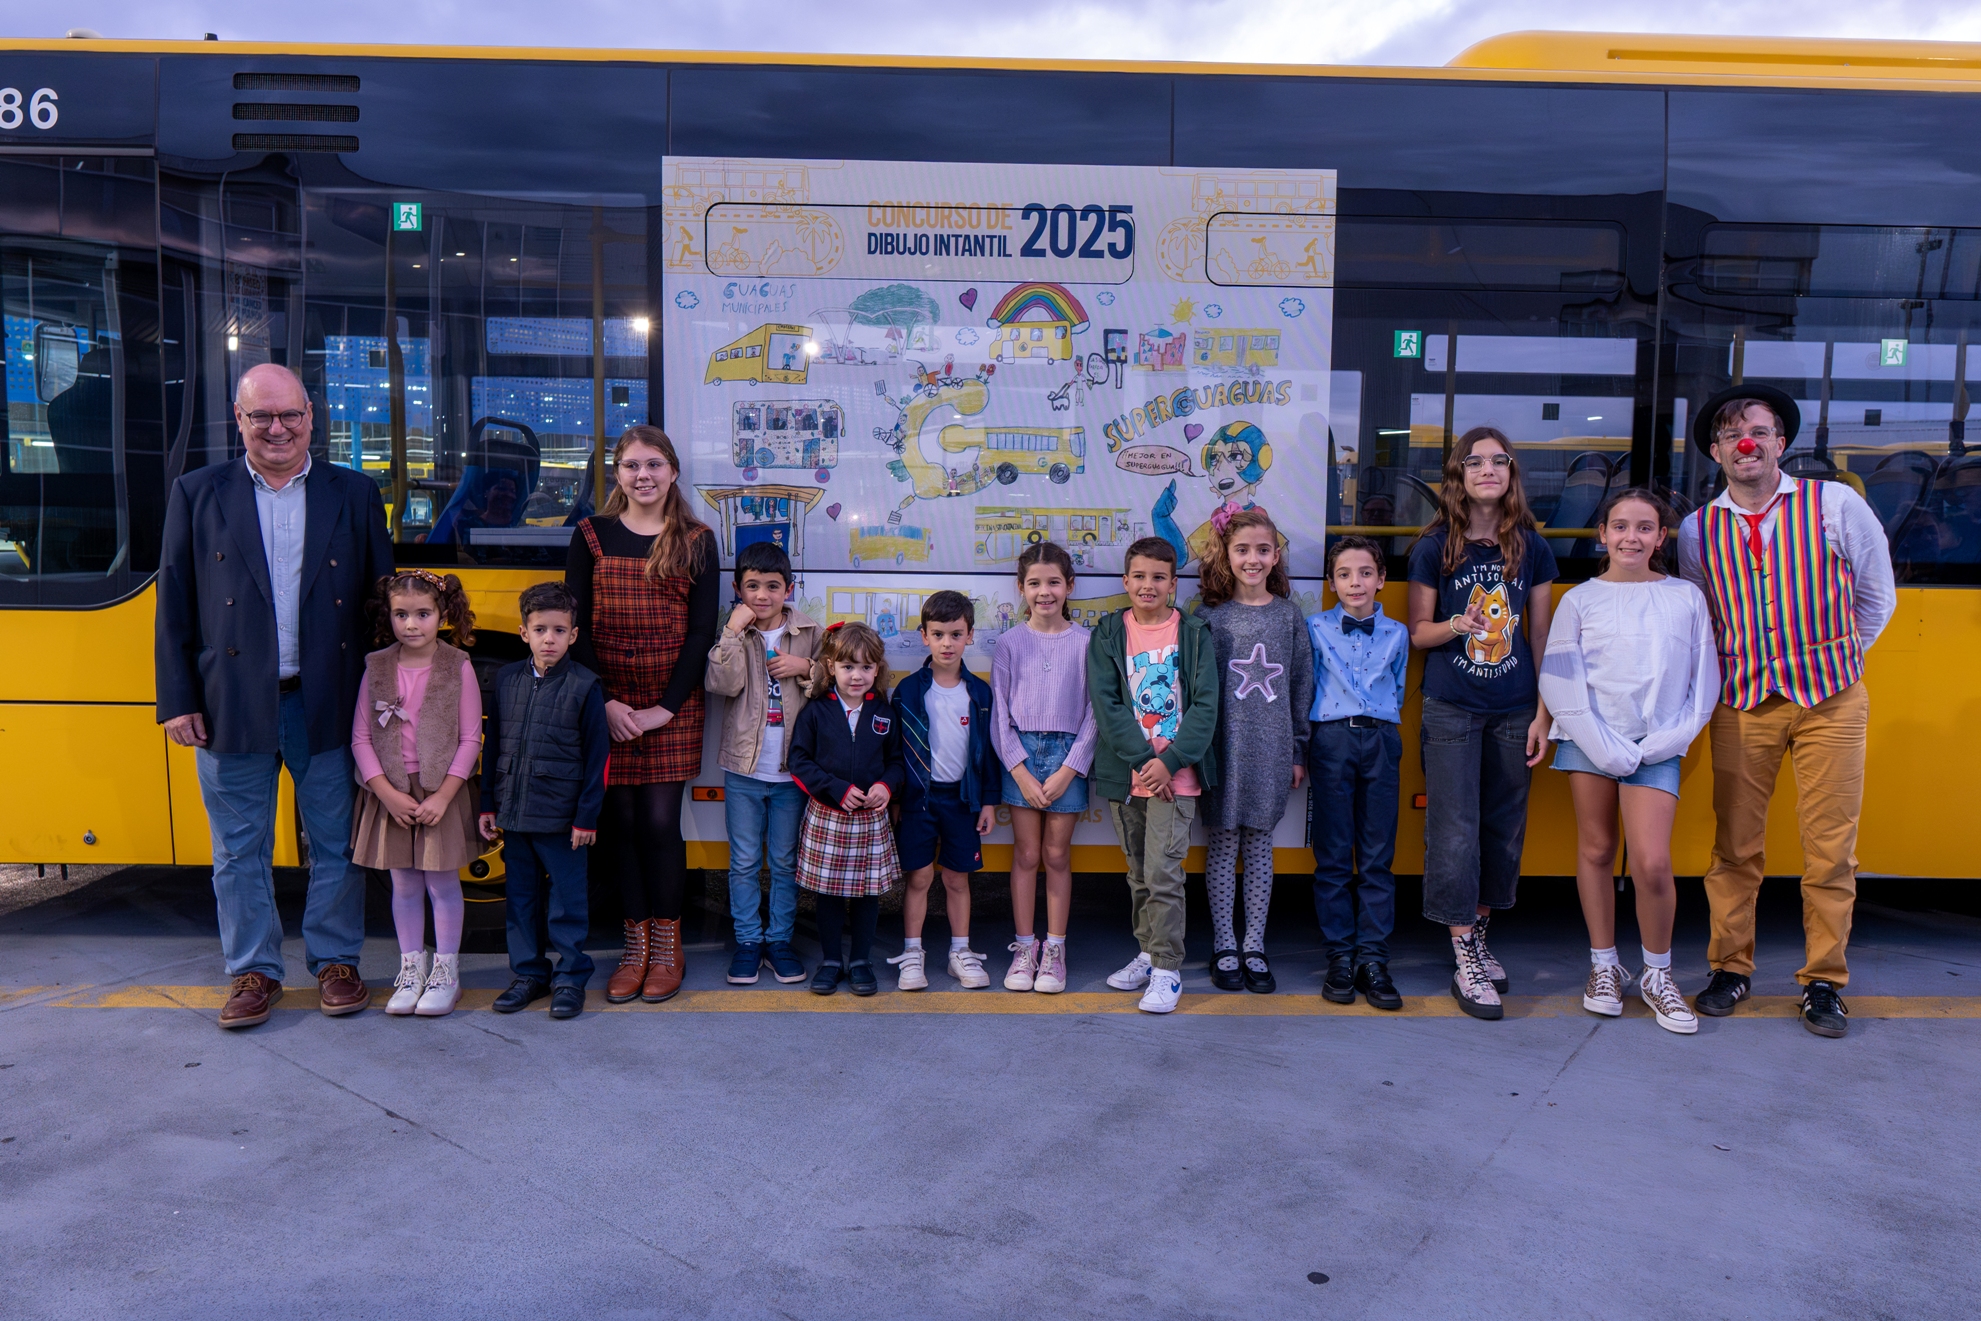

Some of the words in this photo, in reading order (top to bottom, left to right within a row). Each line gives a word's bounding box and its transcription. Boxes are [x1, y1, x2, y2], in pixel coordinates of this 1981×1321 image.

[0, 87, 59, 130] 86
[866, 201, 982, 230] CONCURSO
[986, 202, 1014, 231] DE
[866, 232, 930, 256] DIBUJO
[933, 233, 1013, 258] INTANTIL
[1019, 202, 1134, 260] 2025
[723, 282, 797, 299] GUAGUAS
[1103, 380, 1293, 454] SUPERGUAGUAS
[1473, 564, 1487, 573] I'M
[1453, 655, 1467, 669] I'M
